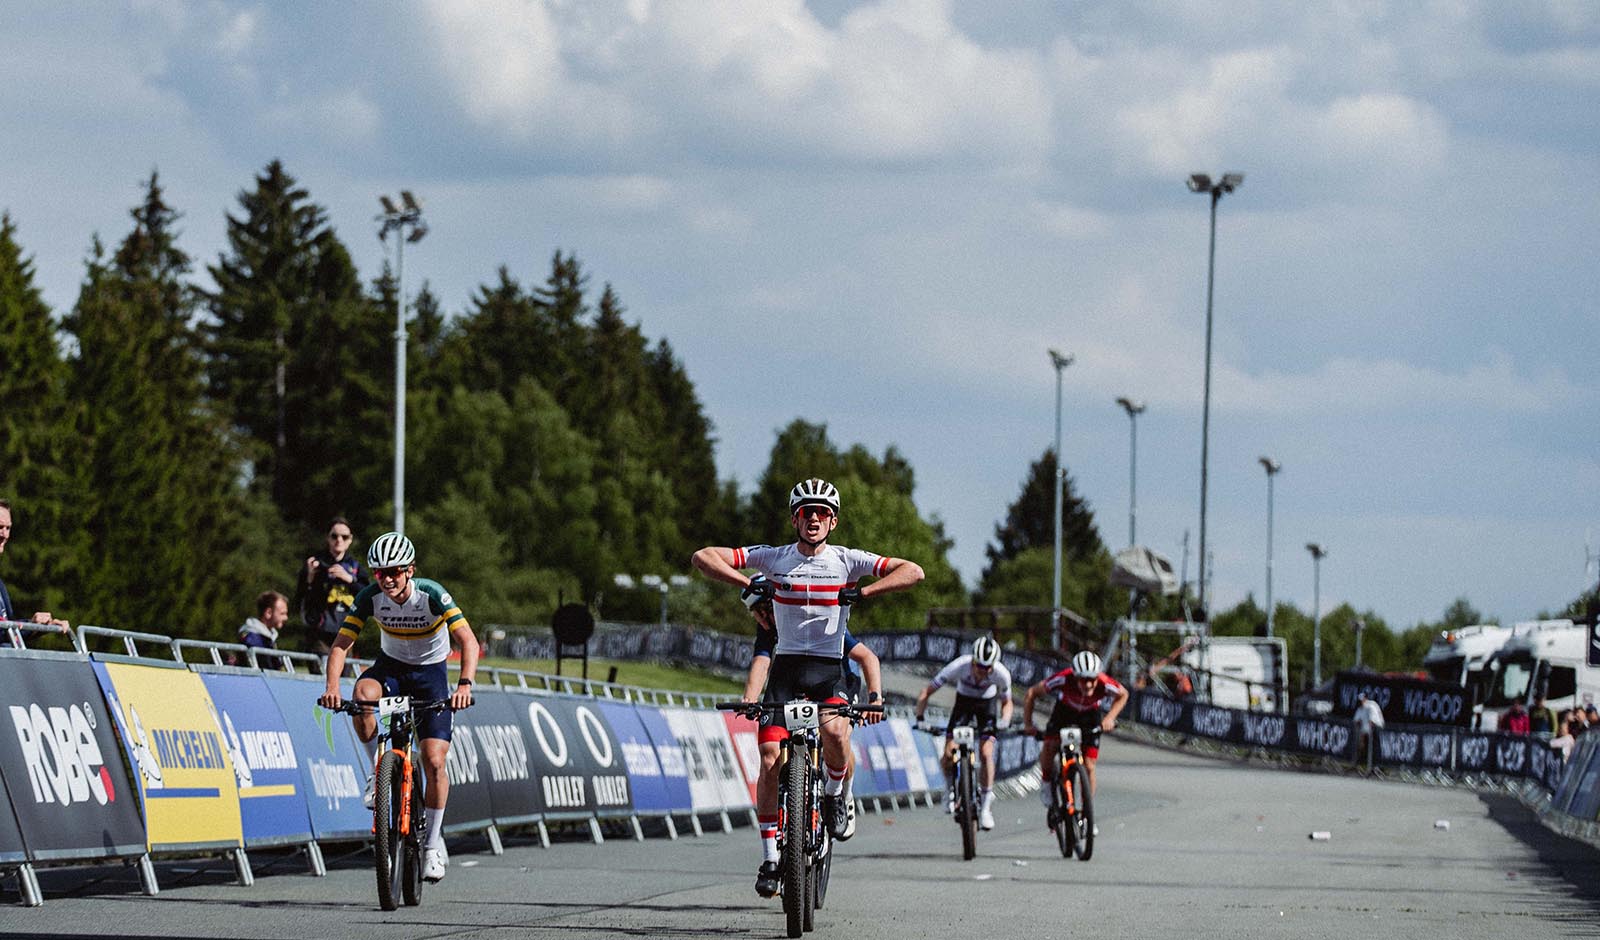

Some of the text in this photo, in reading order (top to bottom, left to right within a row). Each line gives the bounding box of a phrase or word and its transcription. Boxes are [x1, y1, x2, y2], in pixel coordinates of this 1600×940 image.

[790, 706, 814, 720] 19
[1140, 695, 1183, 727] WHOOP
[1403, 688, 1462, 721] WHOOP
[1193, 705, 1233, 737] WHOOP
[1243, 713, 1285, 745] WHOOP
[1296, 720, 1349, 754] WHOOP
[151, 729, 226, 769] MICHELIN
[241, 730, 298, 770] MICHELIN
[475, 724, 529, 782] WHOOP
[1380, 731, 1419, 761] WHOOP
[541, 775, 586, 808] OAKLEY
[591, 775, 629, 806] OAKLEY
